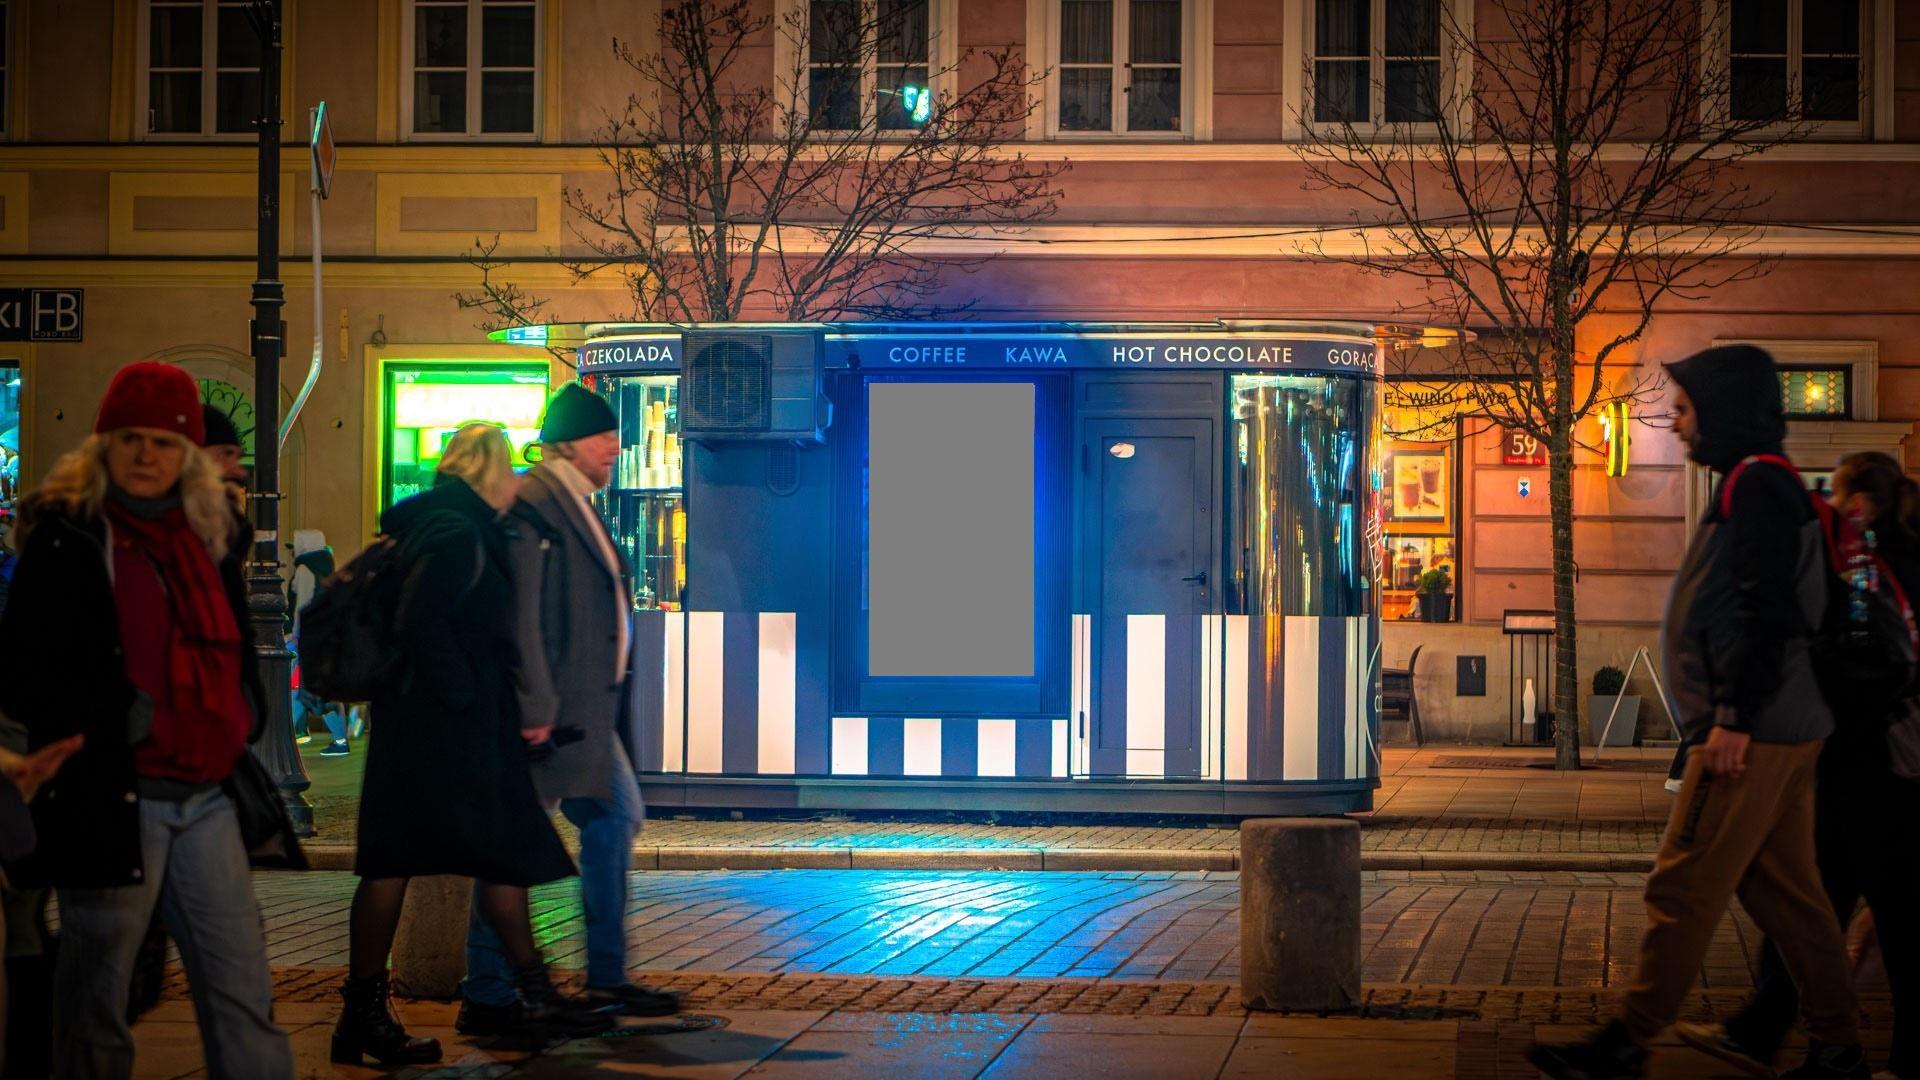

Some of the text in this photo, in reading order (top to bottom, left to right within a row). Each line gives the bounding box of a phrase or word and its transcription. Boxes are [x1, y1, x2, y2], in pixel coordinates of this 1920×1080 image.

[35, 293, 78, 331] HB
[585, 346, 673, 366] CZEKOLADA
[889, 348, 966, 363] COFFEE
[1006, 347, 1067, 362] KAWA
[1113, 347, 1155, 362] HOT
[1164, 347, 1292, 363] CHOCOLATE
[1410, 392, 1453, 406] WINO
[1511, 434, 1537, 455] 59
